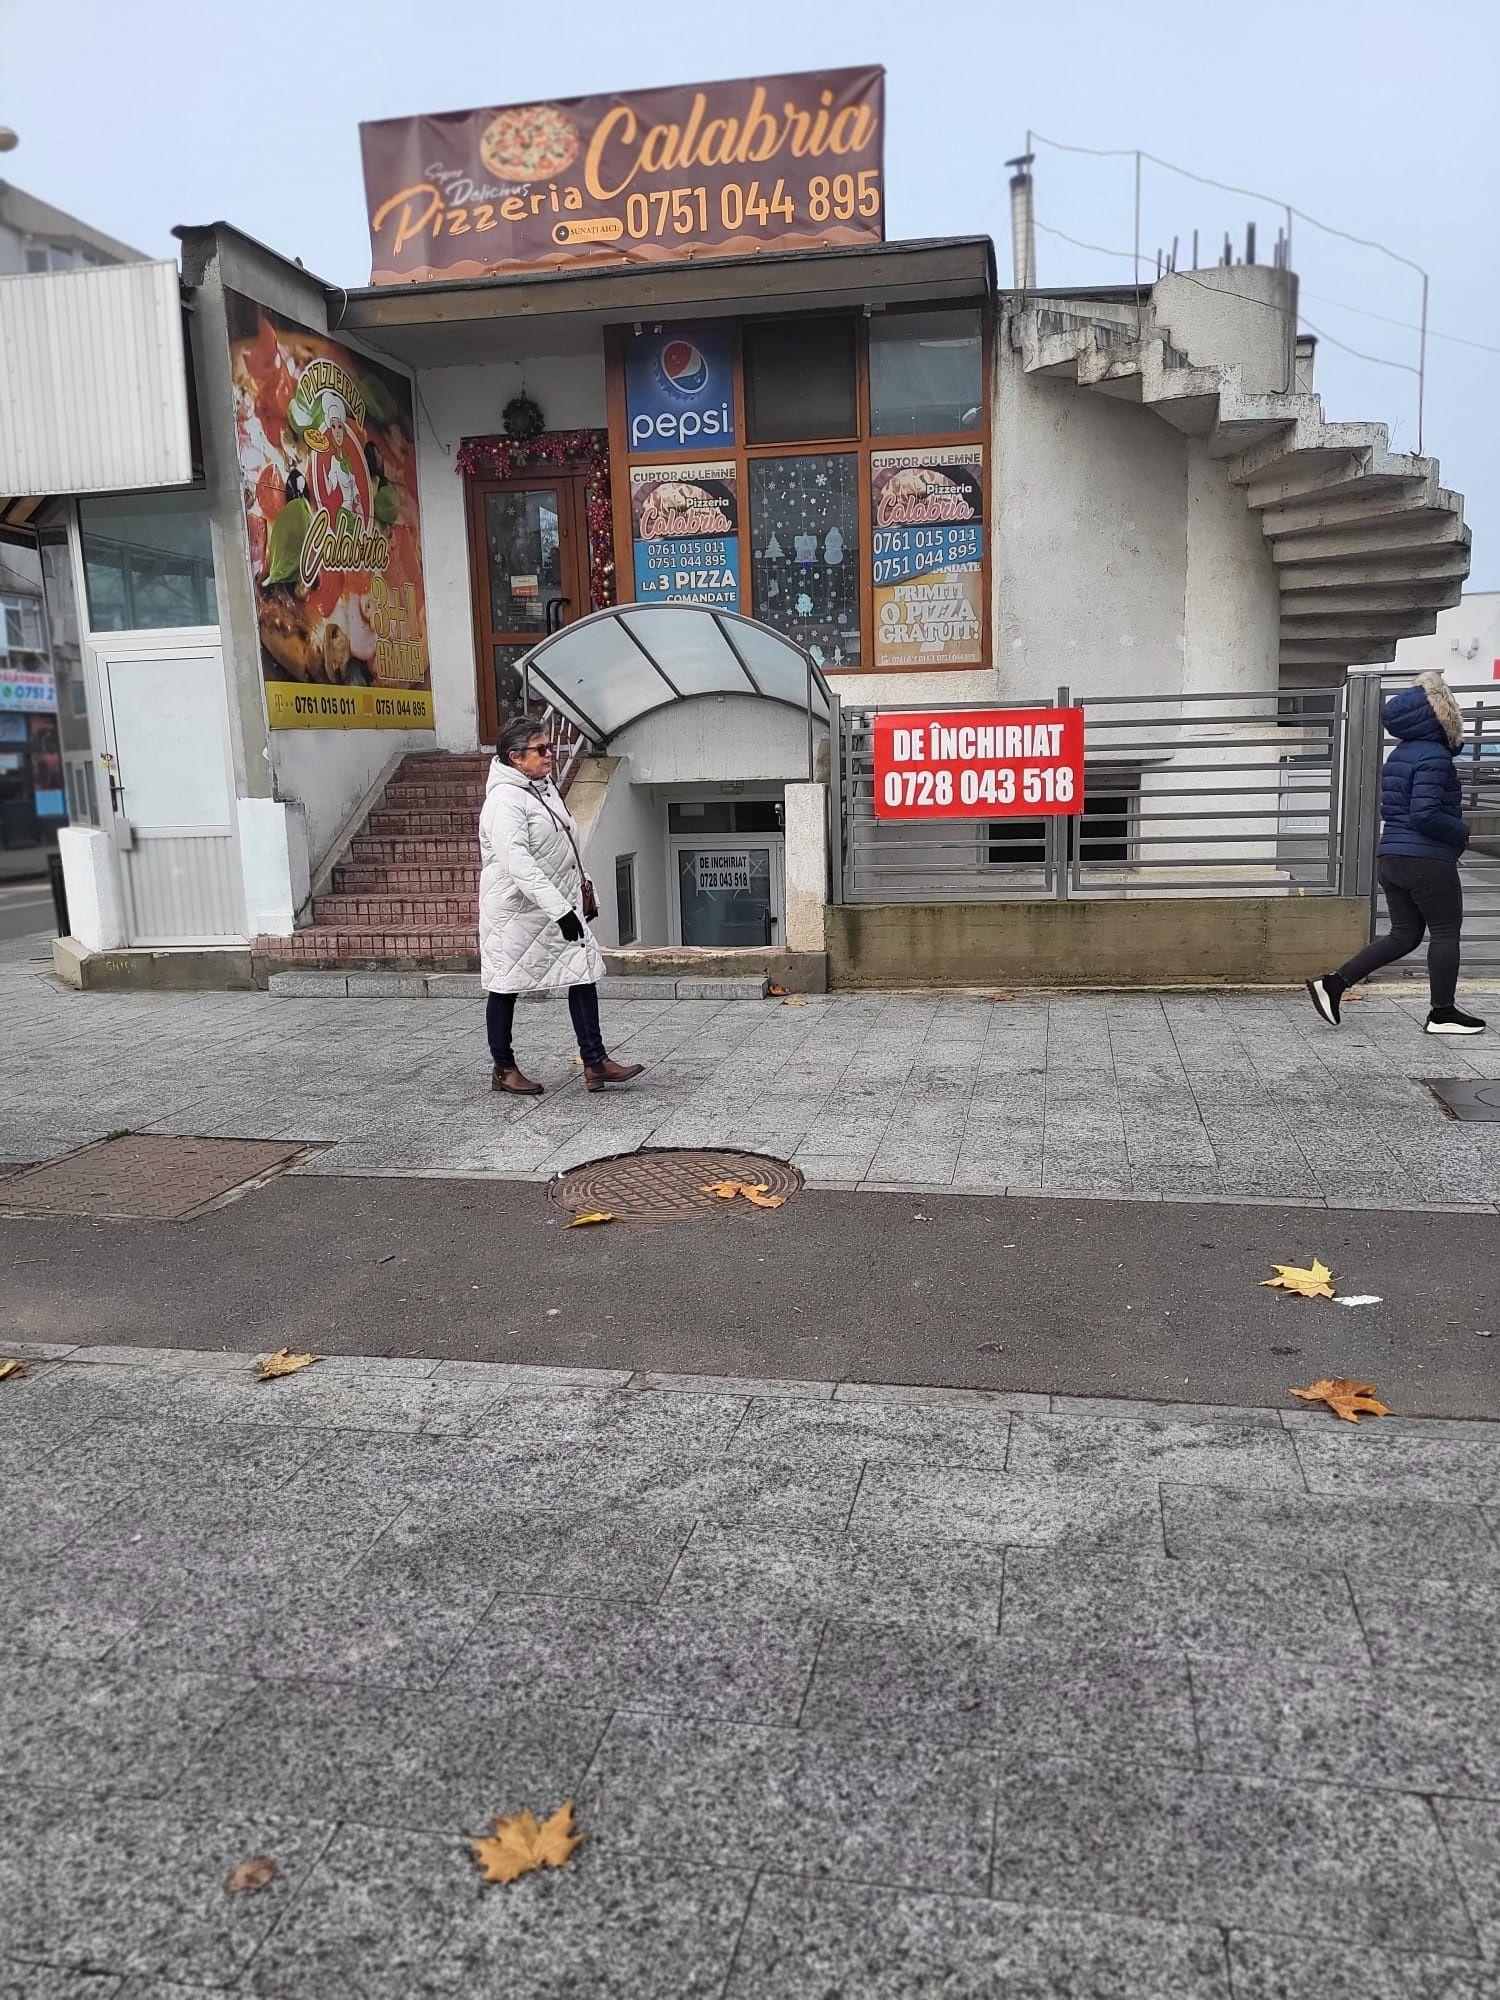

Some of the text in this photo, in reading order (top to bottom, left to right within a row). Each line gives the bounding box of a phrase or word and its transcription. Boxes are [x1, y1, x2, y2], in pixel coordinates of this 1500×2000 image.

[584, 86, 879, 200] Calabria
[447, 179, 532, 207] Delicious
[626, 169, 880, 239] 0751 044 895
[372, 184, 583, 256] Pizzeria
[300, 361, 365, 427] PIZZERIA
[632, 403, 728, 446] pepsi
[872, 453, 981, 468] CUPTOR CU LEMNE
[633, 468, 736, 482] CUPTOR CU LEMNE
[686, 496, 729, 508] Pizzeria
[926, 484, 973, 495] Pizzeria
[640, 506, 732, 540] Calabria
[877, 495, 974, 528] Calabria
[301, 509, 389, 584] Calabria
[648, 541, 726, 556] 0761 015 011
[873, 528, 977, 555] 0761 015 011
[648, 554, 727, 569] 0751 044 895
[873, 543, 977, 583] 0751 044 895
[642, 569, 737, 591] LA 3 PIZZA
[371, 576, 423, 640] 3+1
[666, 592, 737, 603] COMANDATE
[880, 598, 977, 625] O PIZZA
[879, 620, 980, 644] GRATUIT!
[295, 695, 355, 715] 0761 015 011
[375, 698, 426, 716] 0751 044 895
[893, 721, 1065, 761] DE ÎNCHIRIAT
[884, 766, 1074, 807] 0728 043 518
[700, 856, 747, 869] DE INCHIRIAT
[700, 871, 748, 888] 0728 043 518
